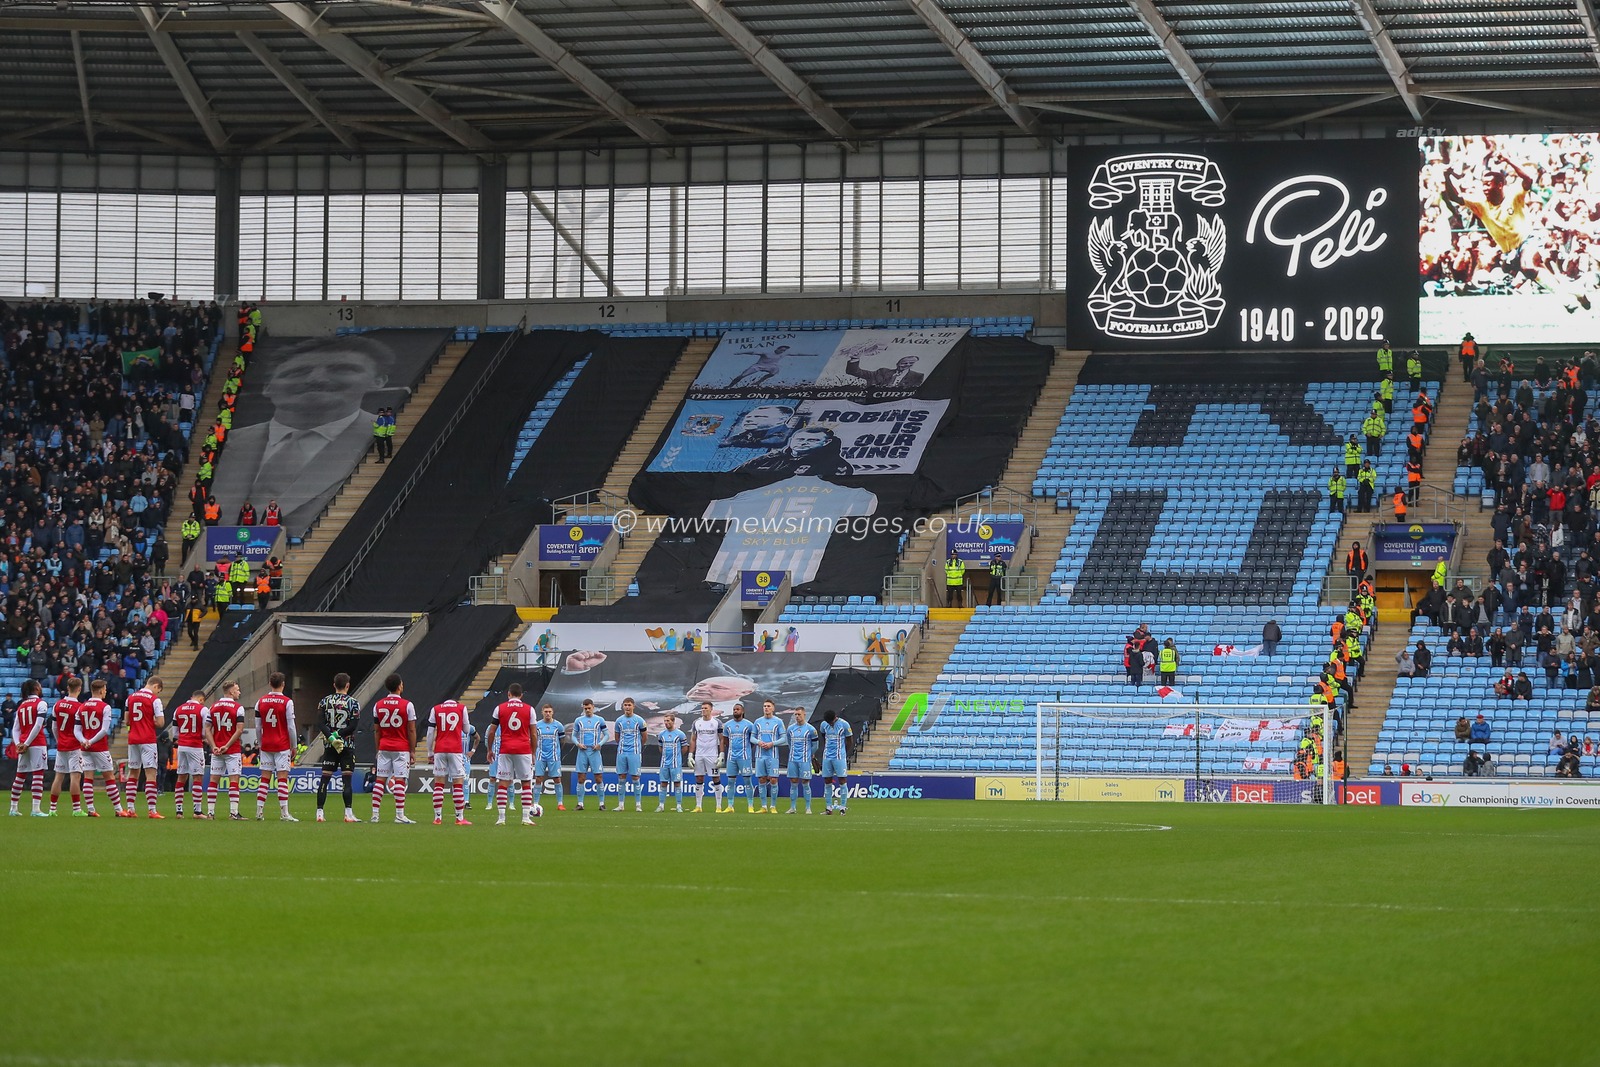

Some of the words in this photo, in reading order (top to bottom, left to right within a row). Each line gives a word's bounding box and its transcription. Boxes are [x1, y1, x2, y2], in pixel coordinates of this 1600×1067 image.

[1396, 126, 1447, 138] adi.tv
[1110, 159, 1174, 174] COVENTRY
[1174, 159, 1205, 172] CITY
[598, 305, 615, 318] 12
[886, 299, 900, 312] 11
[337, 308, 353, 321] 13
[1108, 320, 1172, 334] FOOTBALL
[1172, 319, 1204, 332] CLUB
[1239, 307, 1295, 342] 1940
[1324, 306, 1384, 341] 2022
[726, 336, 755, 344] THE
[739, 341, 776, 349] MAN
[817, 409, 930, 423] ROBINS
[890, 421, 923, 434] IS
[854, 433, 917, 447] OUR
[841, 446, 911, 459] KING
[763, 486, 833, 496] JAYDEN
[766, 496, 818, 519] 15
[742, 536, 769, 546] SKY
[773, 536, 809, 546] BLUE
[988, 545, 1015, 553] arena
[1419, 545, 1448, 553] arena
[20, 706, 34, 726] 11
[132, 702, 144, 722] 5
[265, 708, 278, 728] 4
[327, 708, 349, 729] 12
[378, 708, 403, 728] 26
[58, 712, 69, 731] 7
[81, 710, 101, 730] 16
[178, 713, 197, 733] 21
[213, 711, 233, 732] 14
[437, 712, 460, 732] 19
[507, 711, 522, 731] 6
[988, 787, 1003, 796] TM
[1158, 790, 1173, 799] TM
[1235, 787, 1269, 803] bet
[1411, 790, 1450, 806] ebay
[1459, 795, 1519, 806] Championing
[1520, 796, 1536, 804] KW
[1538, 796, 1554, 806] Joy
